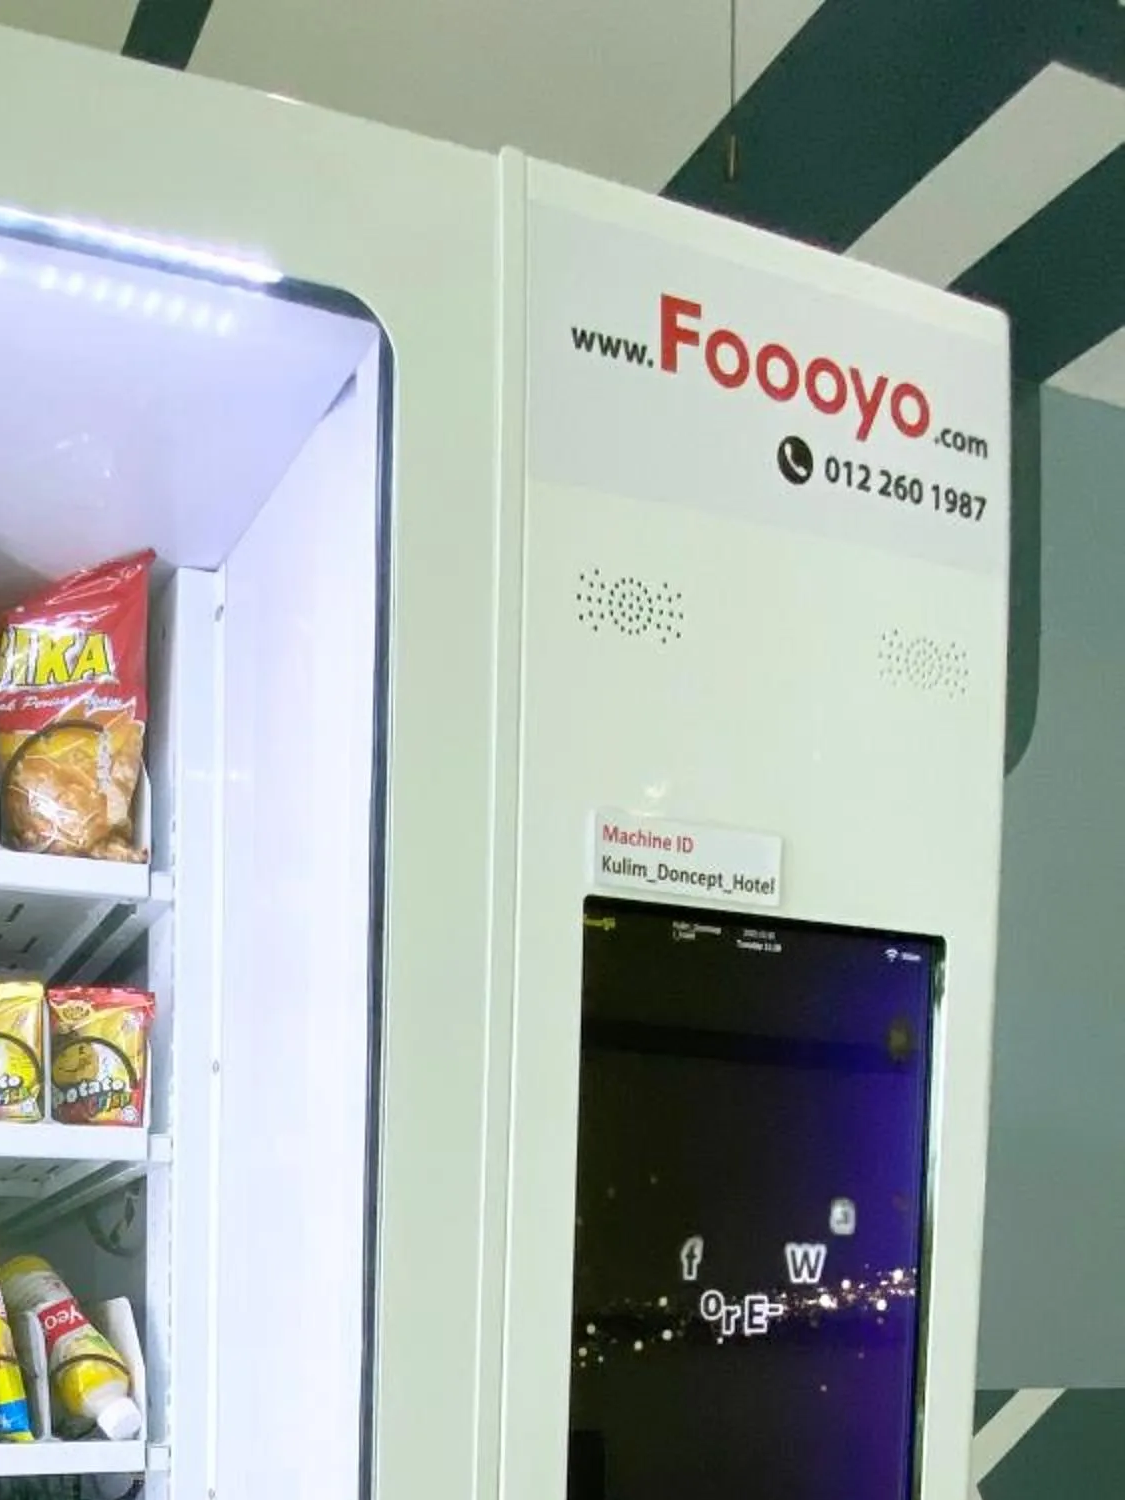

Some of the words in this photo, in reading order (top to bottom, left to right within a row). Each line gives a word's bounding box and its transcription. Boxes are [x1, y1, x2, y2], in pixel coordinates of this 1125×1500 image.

[823, 456, 871, 494] 012
[879, 469, 924, 506] 260
[930, 484, 988, 523] 1987
[601, 824, 672, 852] Machine
[676, 833, 695, 854] ID
[601, 856, 776, 896] Kulim_Doncept_Hotel
